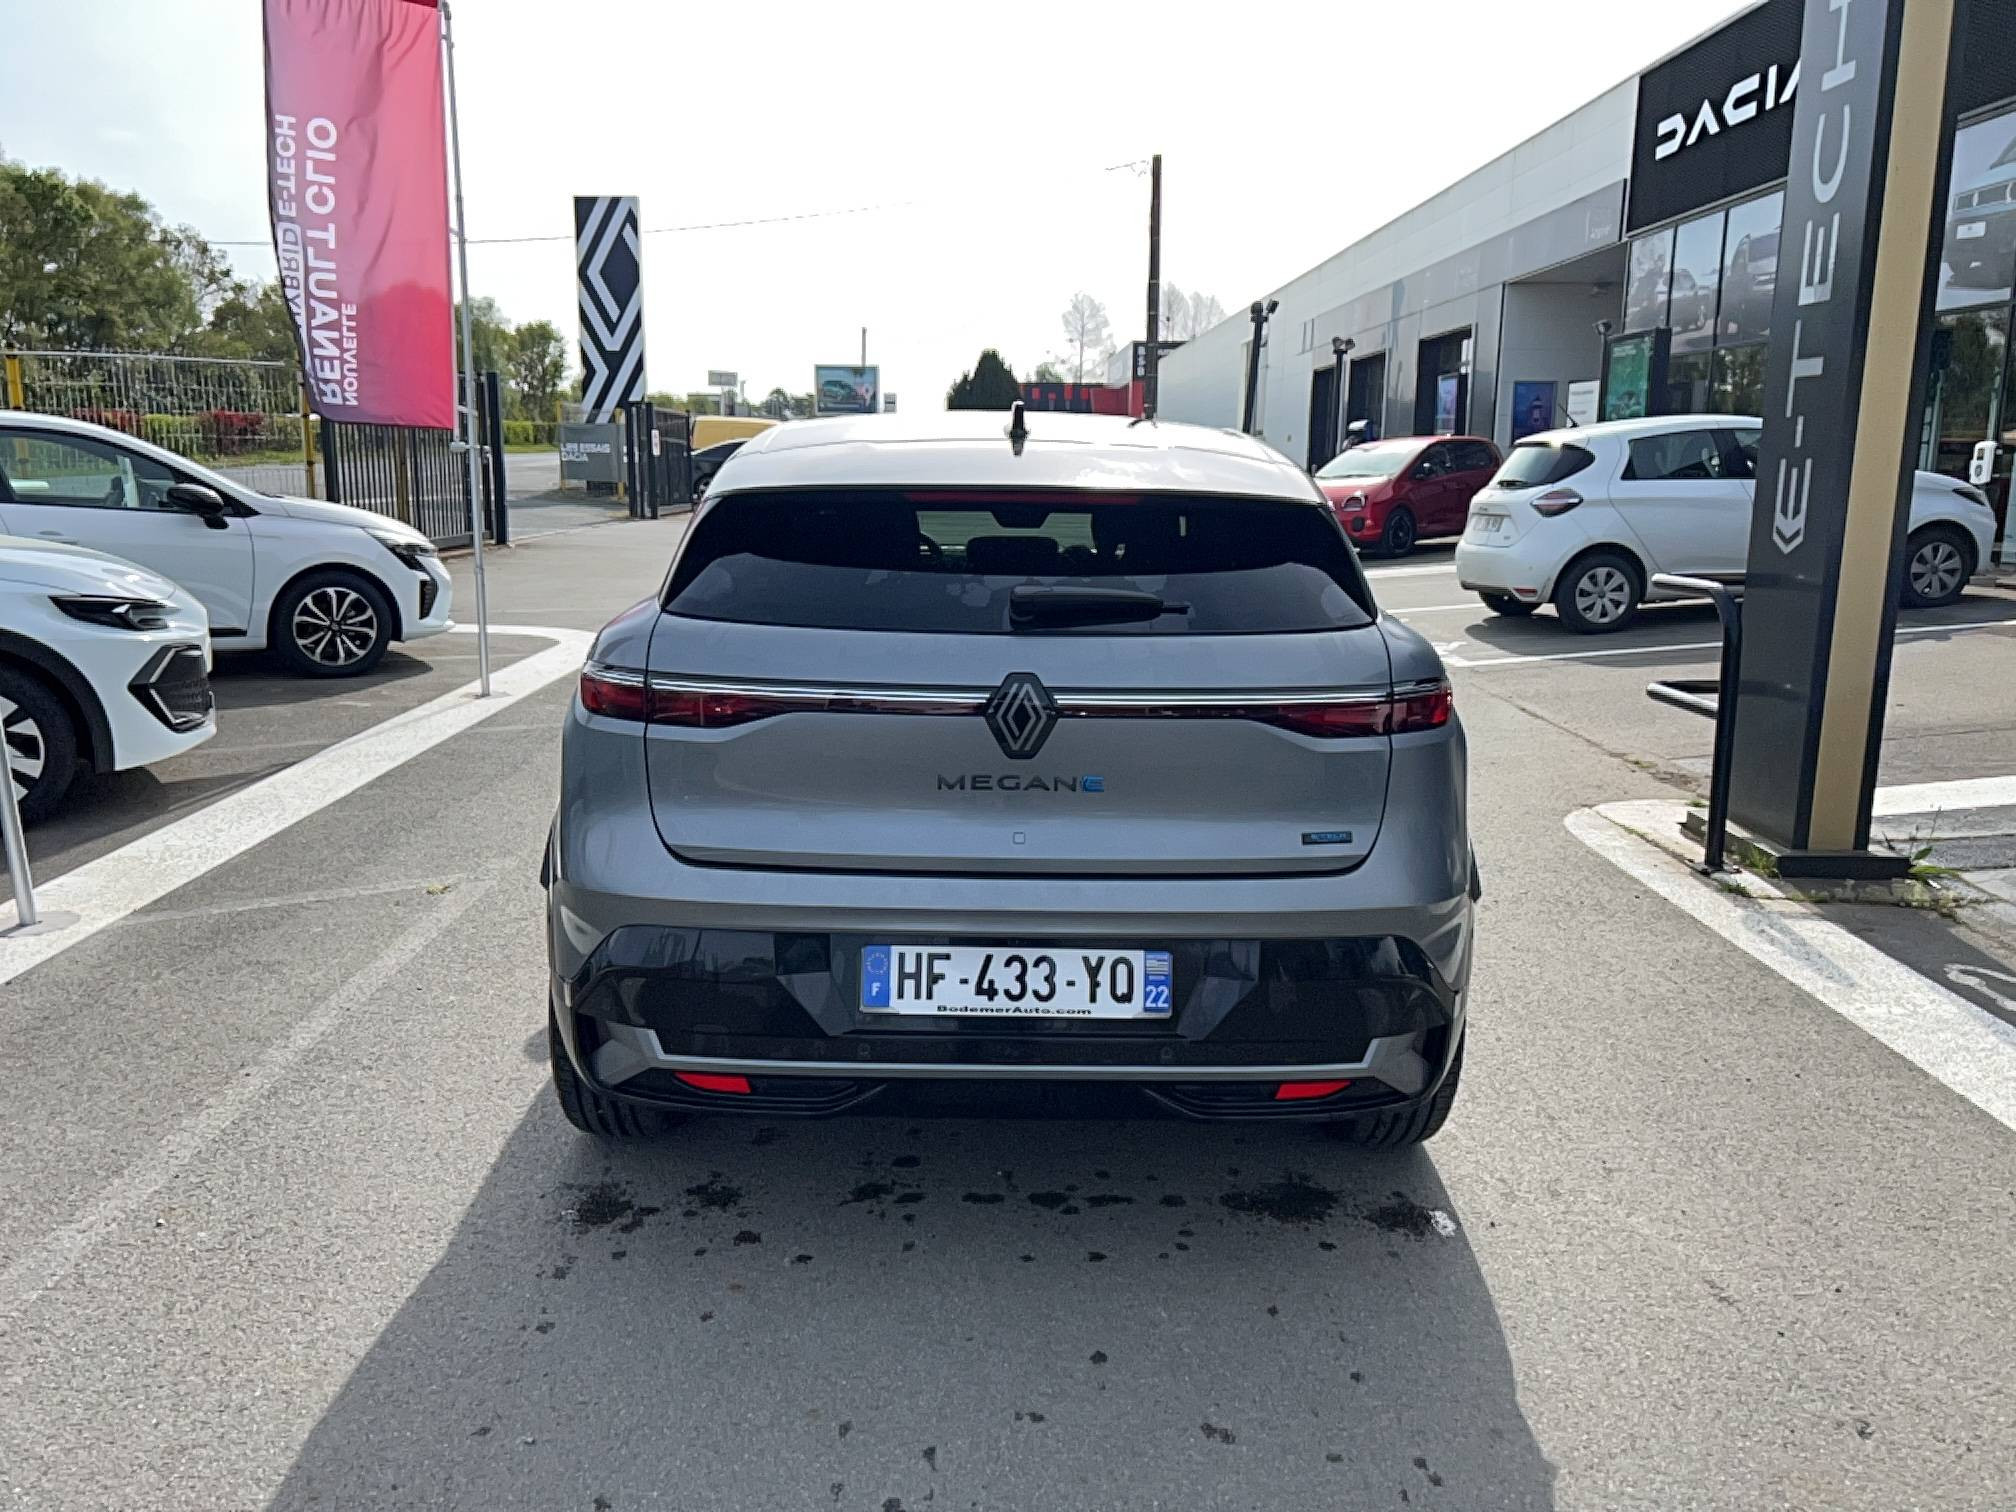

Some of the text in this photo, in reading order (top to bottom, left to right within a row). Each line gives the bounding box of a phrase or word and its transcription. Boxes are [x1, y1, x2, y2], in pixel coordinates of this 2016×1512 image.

[936, 773, 1105, 793] MEGANE
[896, 951, 1135, 1005] HF-433-YQ
[871, 982, 881, 997] F
[1145, 985, 1169, 1008] 22
[936, 1004, 1093, 1015] BodemerAuto.com
